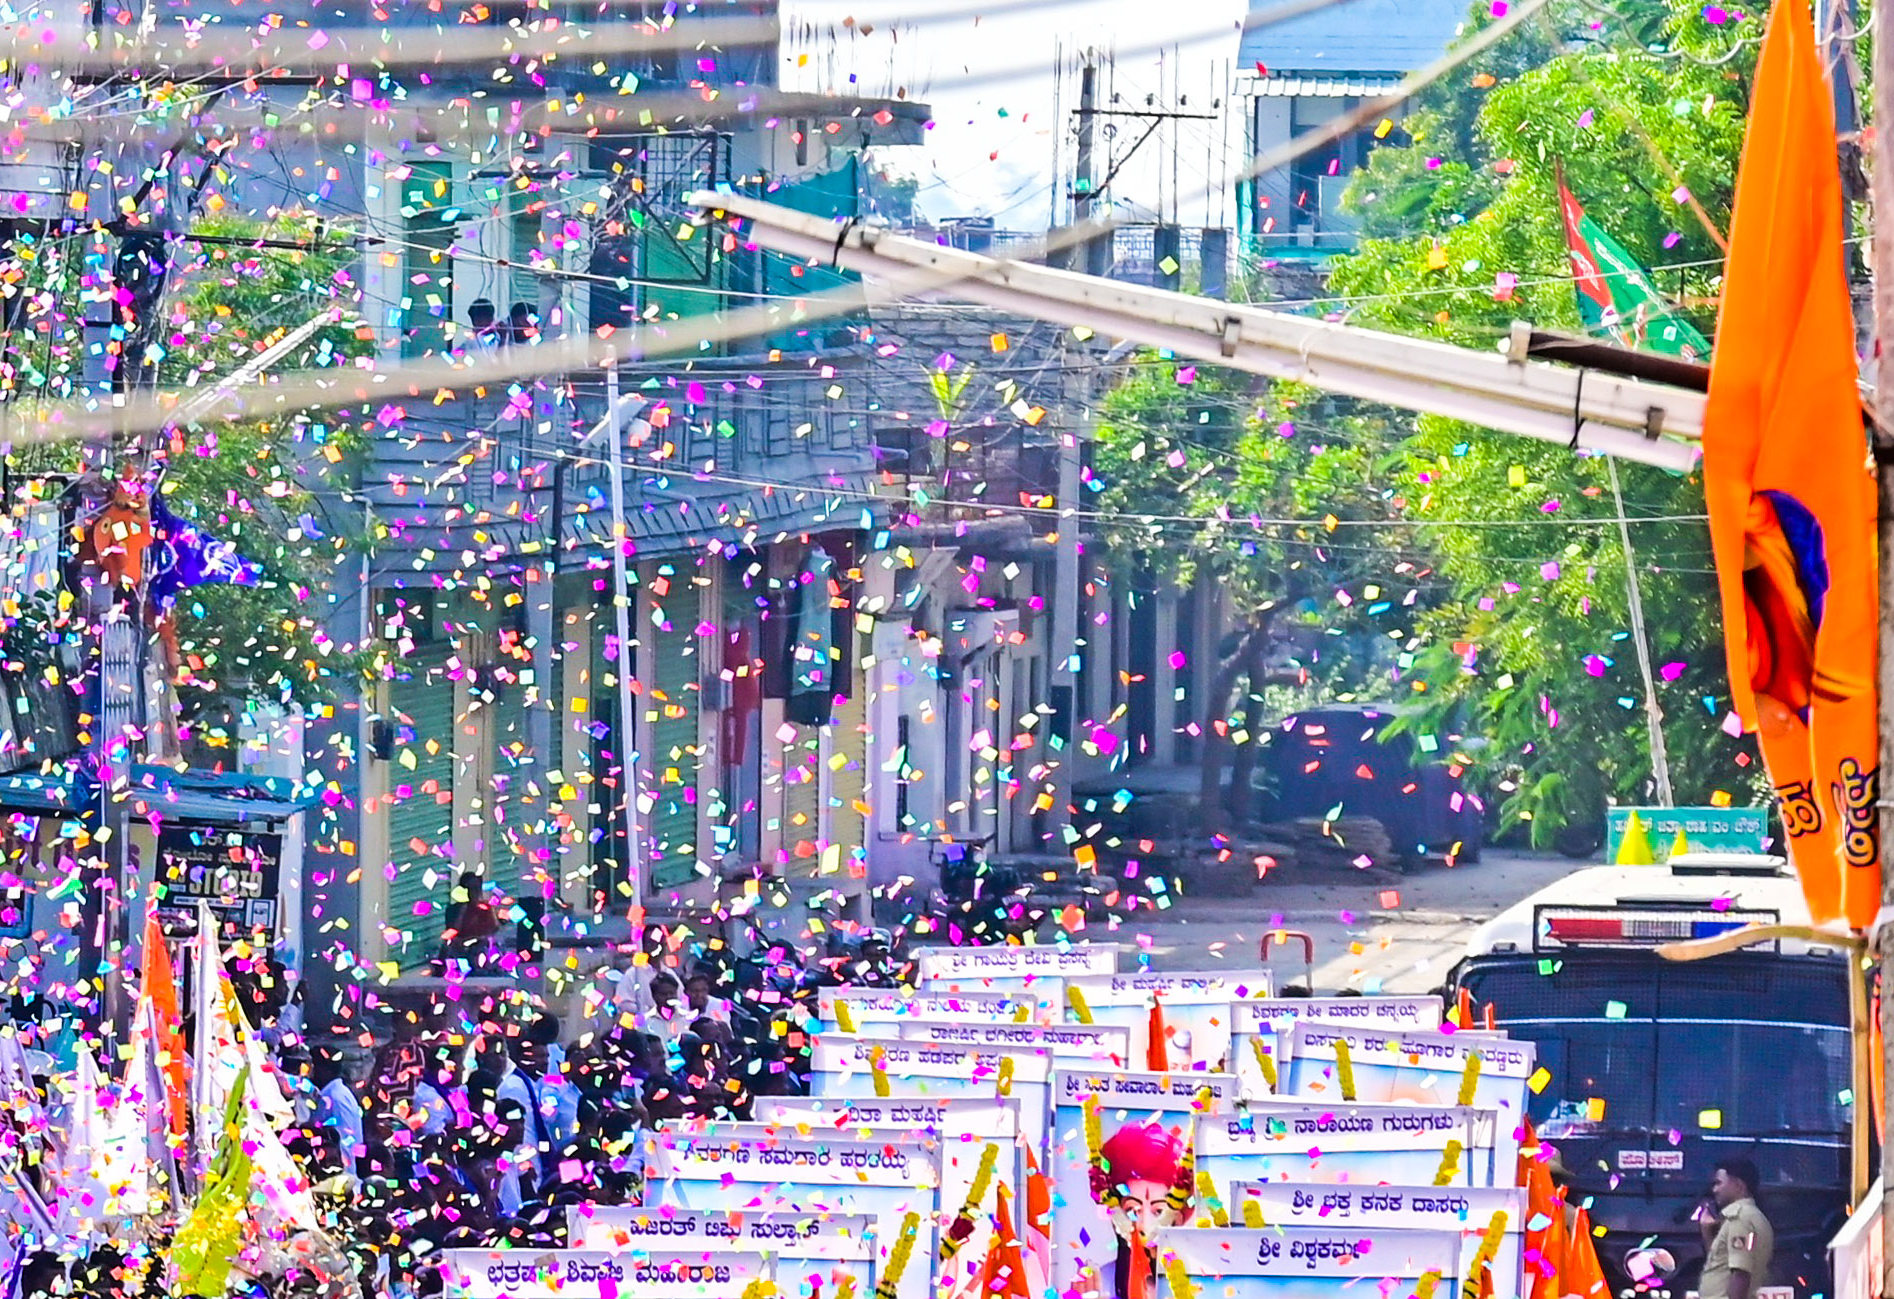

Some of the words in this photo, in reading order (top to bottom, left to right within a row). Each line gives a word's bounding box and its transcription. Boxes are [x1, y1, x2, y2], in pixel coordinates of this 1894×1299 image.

[1292, 1190, 1314, 1215] ಶ್ರೀ
[1323, 1191, 1351, 1216] ಭಕ್ತ
[1360, 1191, 1402, 1211] ಕನಕ
[1411, 1192, 1469, 1214] ದಾಸರು
[1257, 1237, 1280, 1264] ಶ್ರೀ
